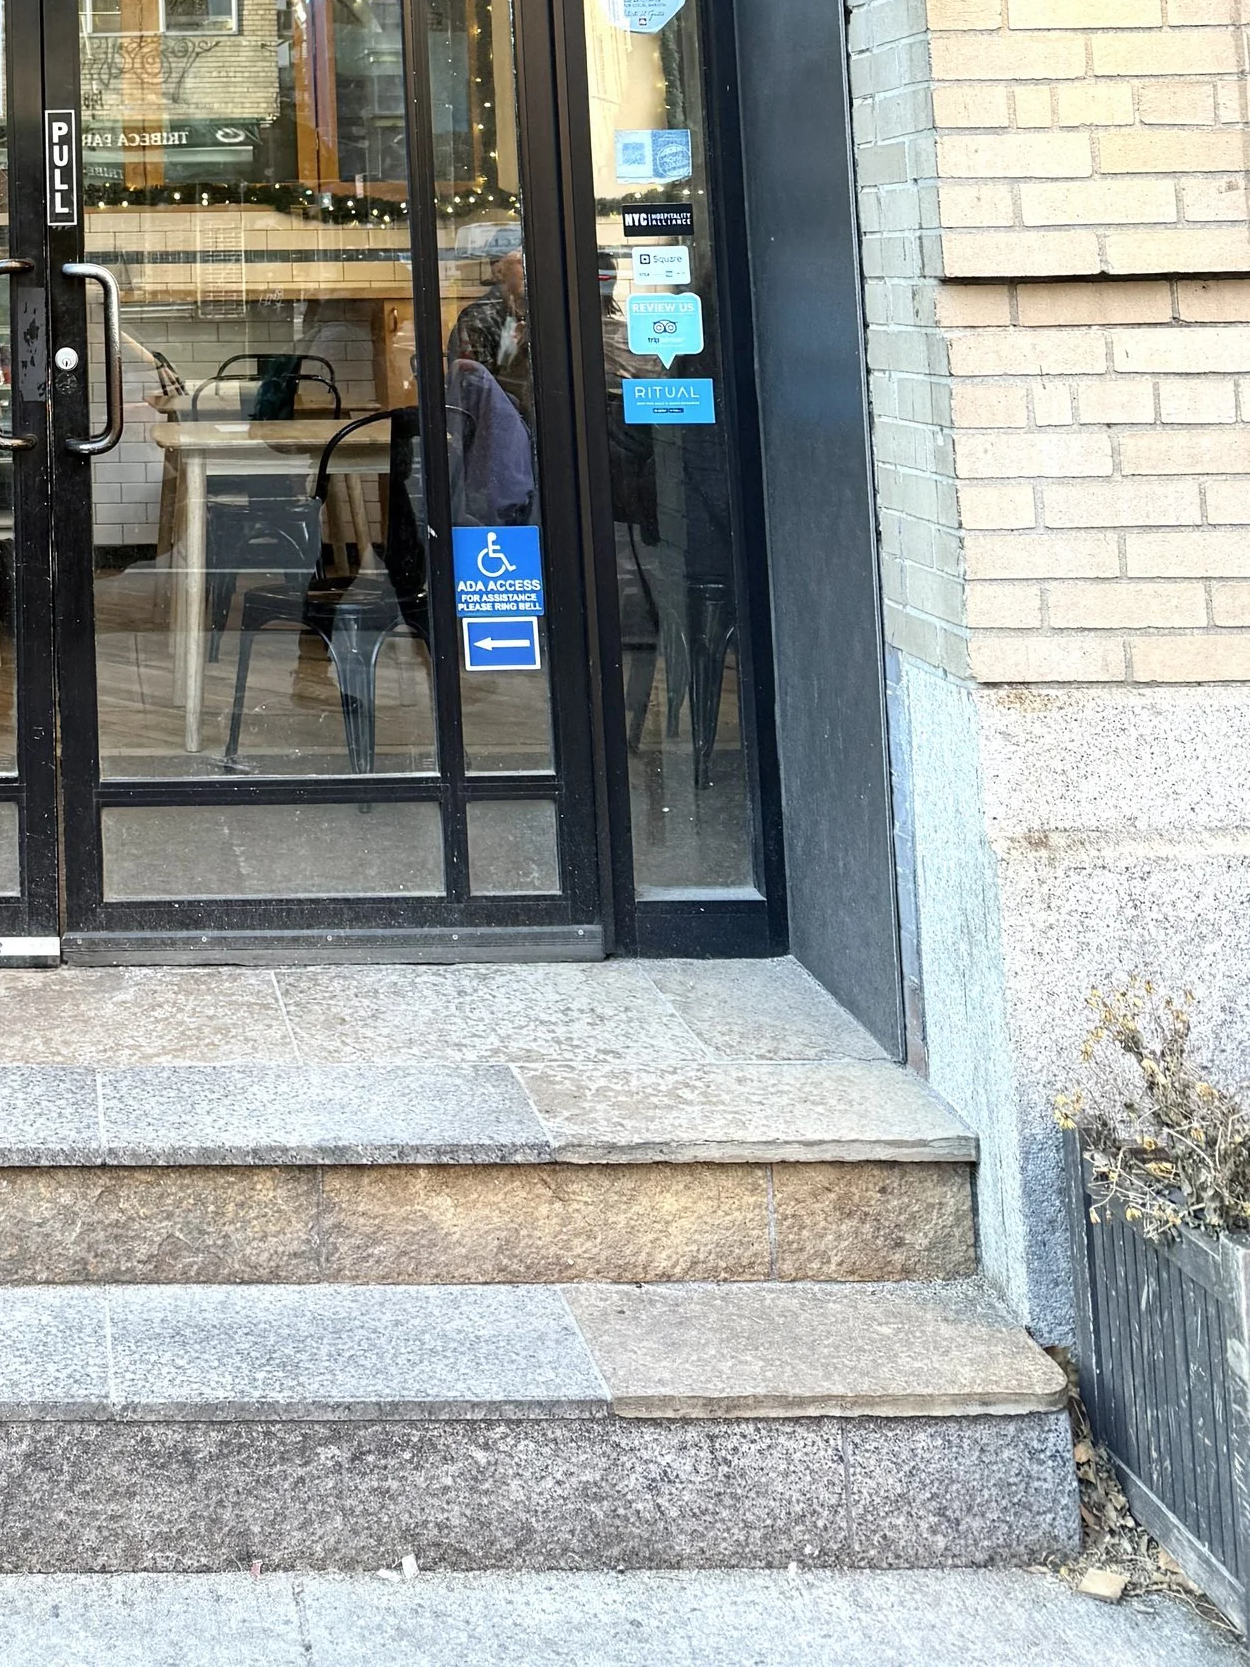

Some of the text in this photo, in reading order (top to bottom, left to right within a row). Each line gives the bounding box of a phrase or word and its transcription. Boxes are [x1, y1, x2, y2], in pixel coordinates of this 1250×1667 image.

[51, 121, 70, 214] PULL
[625, 213, 649, 227] NYC
[653, 255, 683, 264] Square
[632, 302, 695, 313] REVIEW US
[634, 386, 700, 399] RITUAL
[457, 579, 541, 592] ADA ACCESS
[461, 593, 537, 602] FOR ASSISTANCE
[458, 602, 542, 611] PLEASE RING BELL
